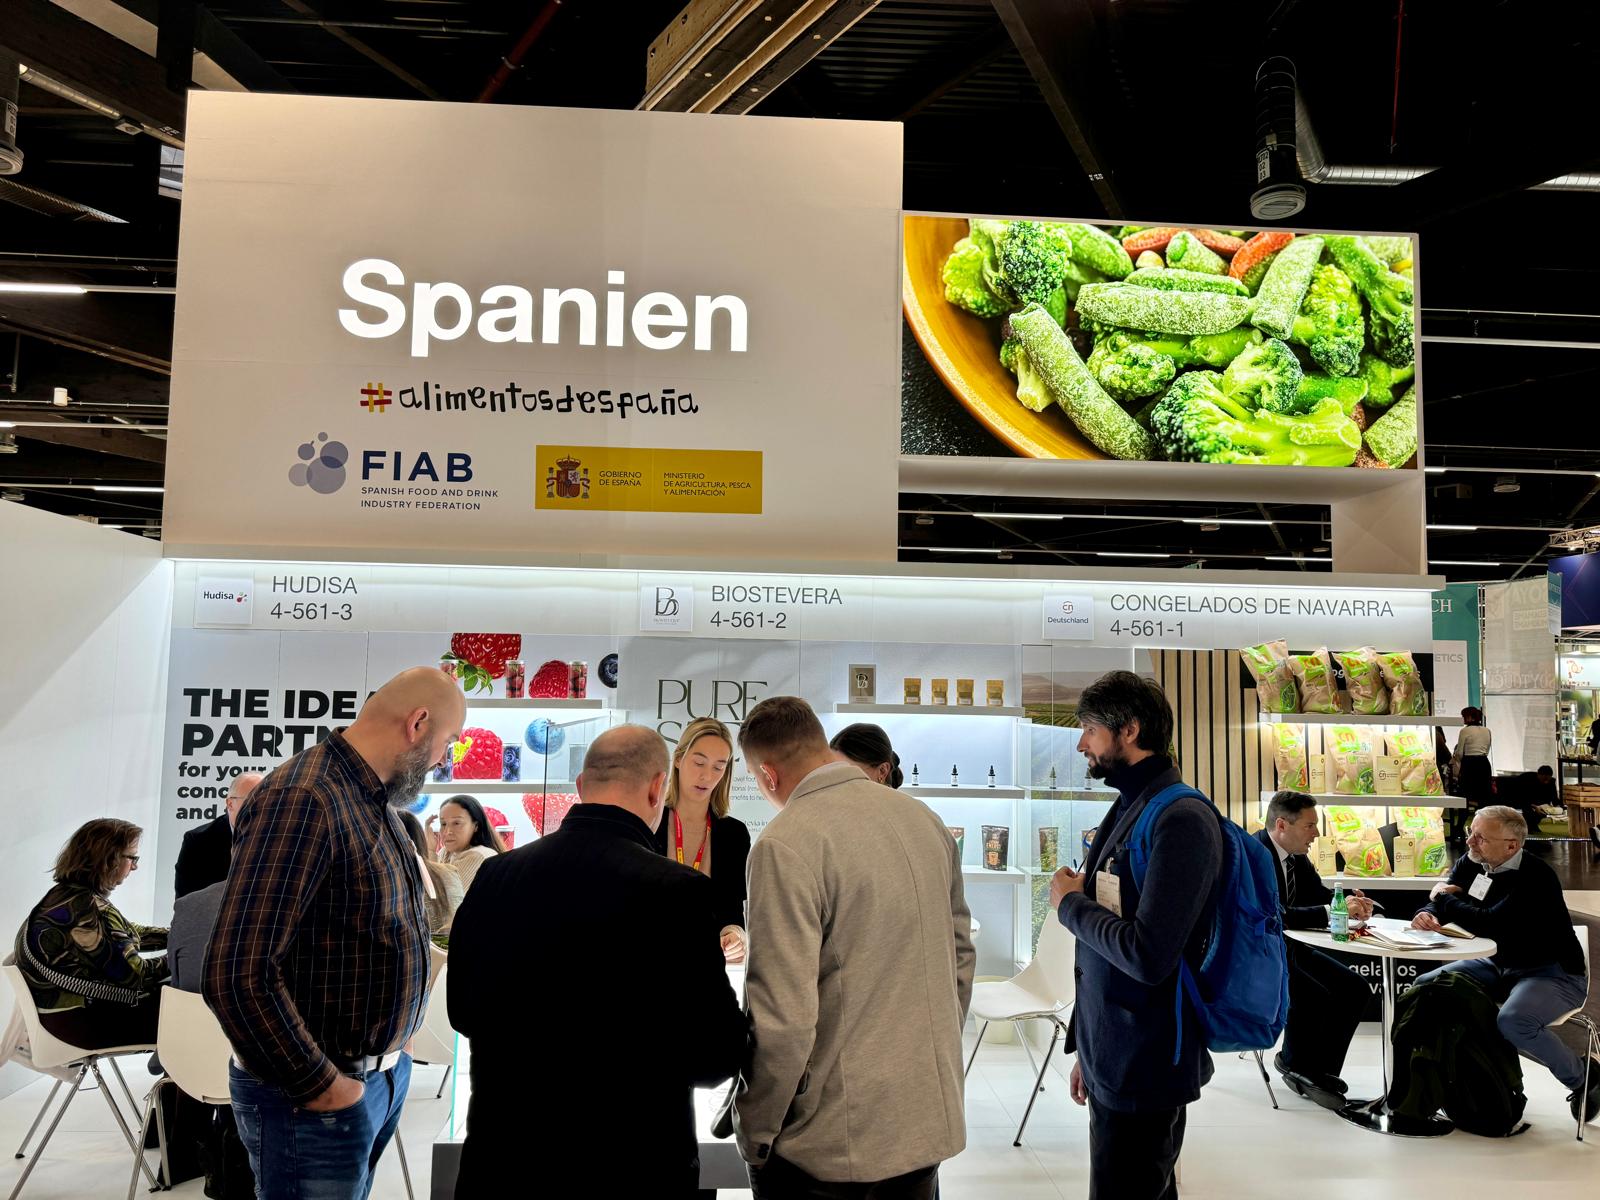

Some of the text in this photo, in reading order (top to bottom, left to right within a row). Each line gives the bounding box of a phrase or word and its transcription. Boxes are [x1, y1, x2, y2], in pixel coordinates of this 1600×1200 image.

[338, 258, 748, 358] Spanien
[360, 381, 699, 419] #alimentosdespaña
[362, 450, 474, 482] FIAB
[599, 470, 642, 478] GOBIERNO
[612, 479, 642, 487] ESPAÑA
[663, 472, 705, 480] MINISTERIO
[361, 486, 499, 498] SPANISH FOOD AND DRINK
[663, 488, 726, 497] Y ALIMENTACIÓN
[361, 500, 481, 510] INDUSTRY FEDERATION
[272, 576, 358, 594] HUDISA
[203, 591, 234, 600] Hudisa
[712, 585, 843, 605] BIOSTEVERA
[270, 602, 353, 620] 4-561-3
[1110, 594, 1395, 617] CONGELADOS DE NAVARRA
[710, 610, 787, 629] 4-561-2
[1047, 616, 1089, 624] Deutschland
[1110, 619, 1184, 637] 4-561-1
[183, 688, 374, 719] THE IDE
[178, 762, 211, 777] for
[175, 804, 218, 820] and
